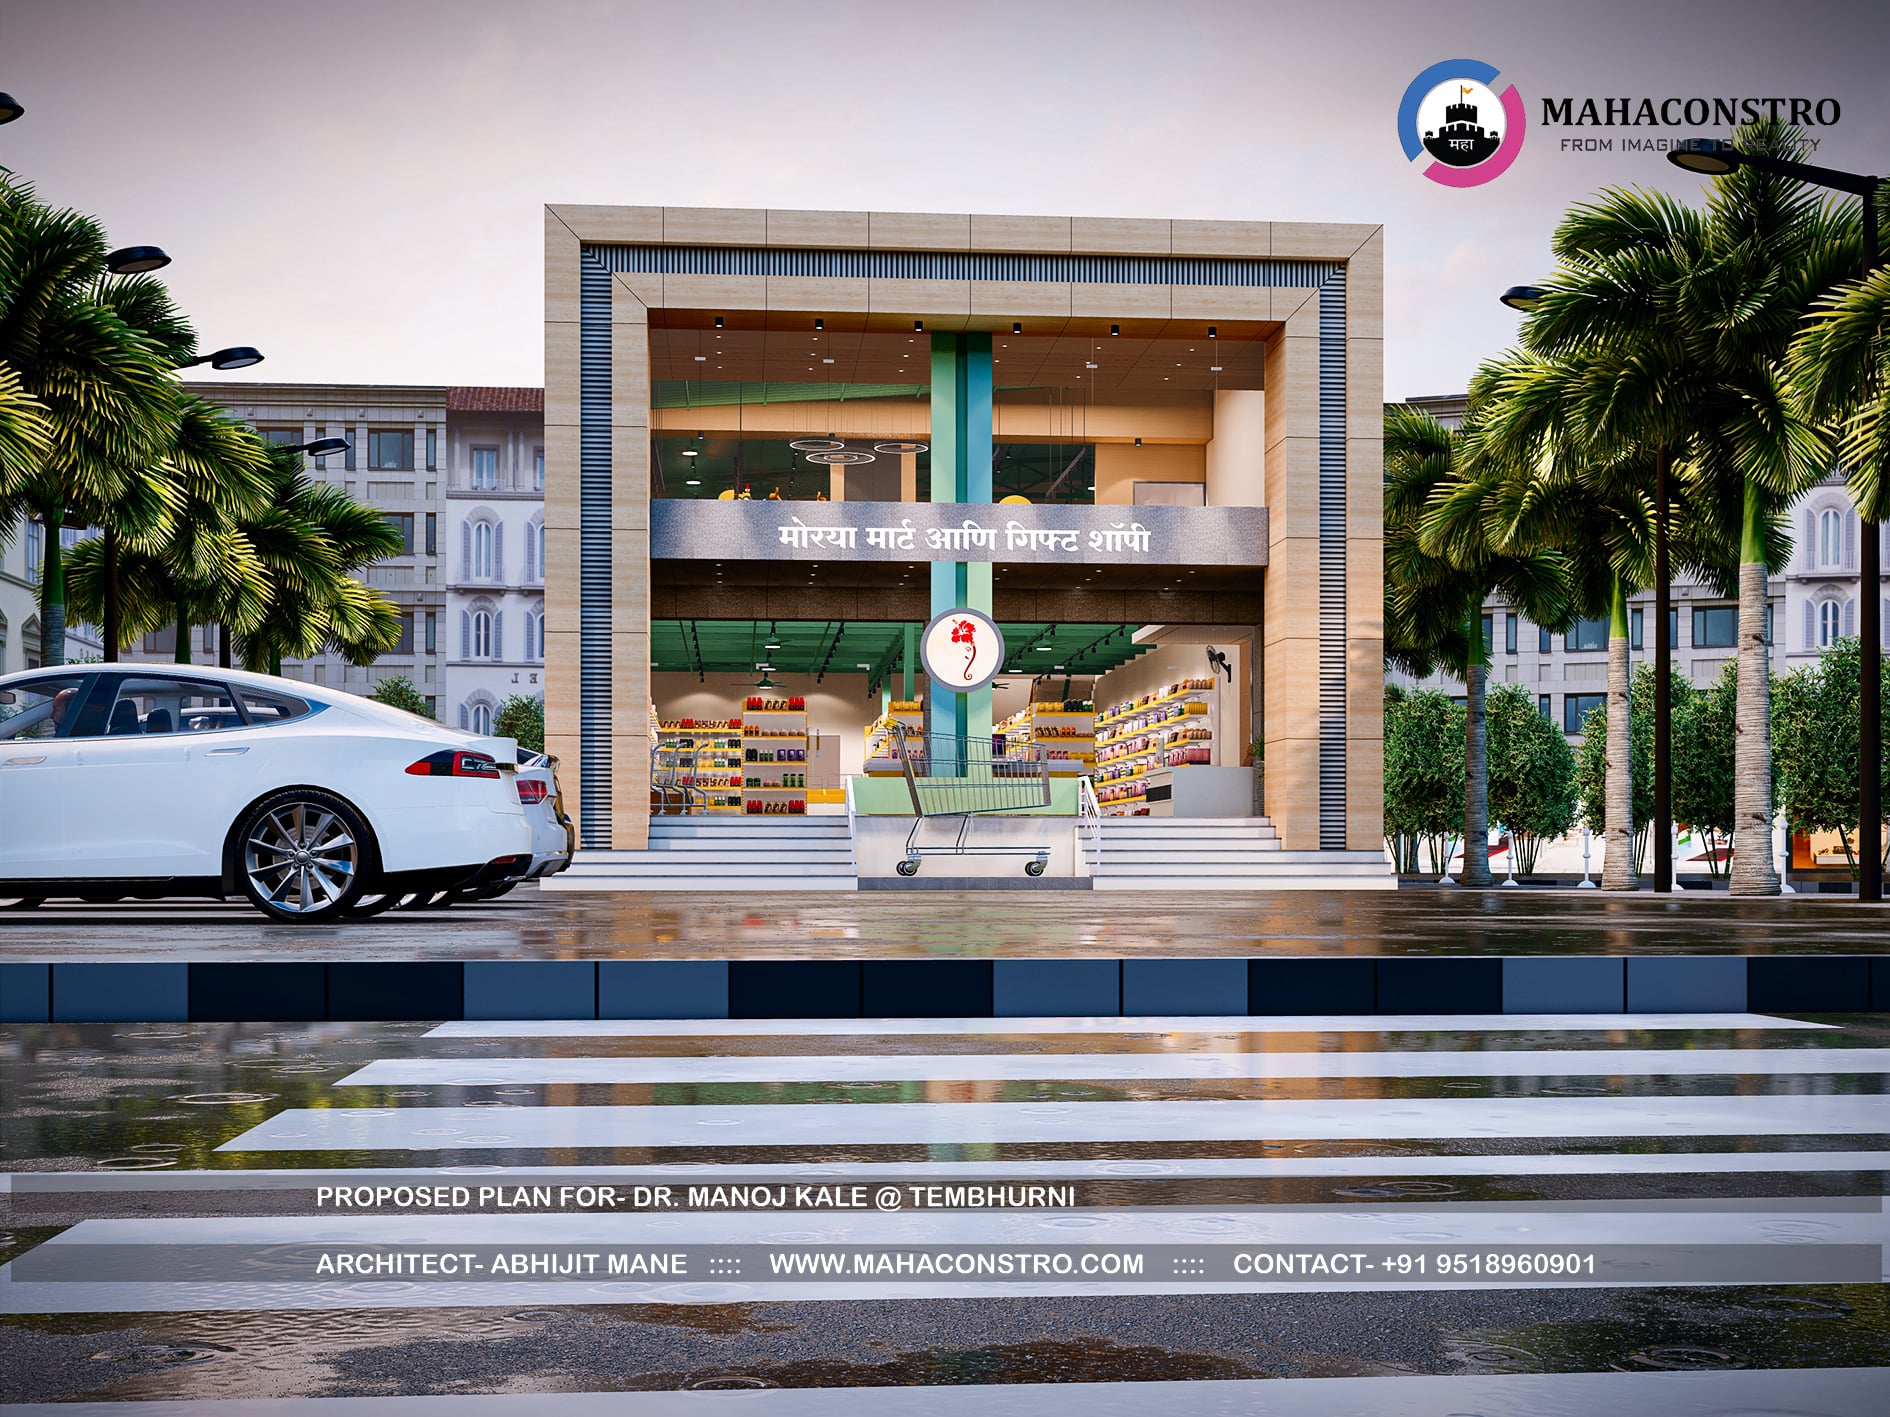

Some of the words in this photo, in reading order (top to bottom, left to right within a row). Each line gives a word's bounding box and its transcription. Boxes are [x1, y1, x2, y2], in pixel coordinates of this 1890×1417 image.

[777, 516, 858, 550] मोरया
[865, 518, 917, 550] मार्ट
[924, 519, 998, 551] आणि
[1004, 520, 1081, 552] गिफ्ट
[1088, 522, 1152, 553] शॉपी
